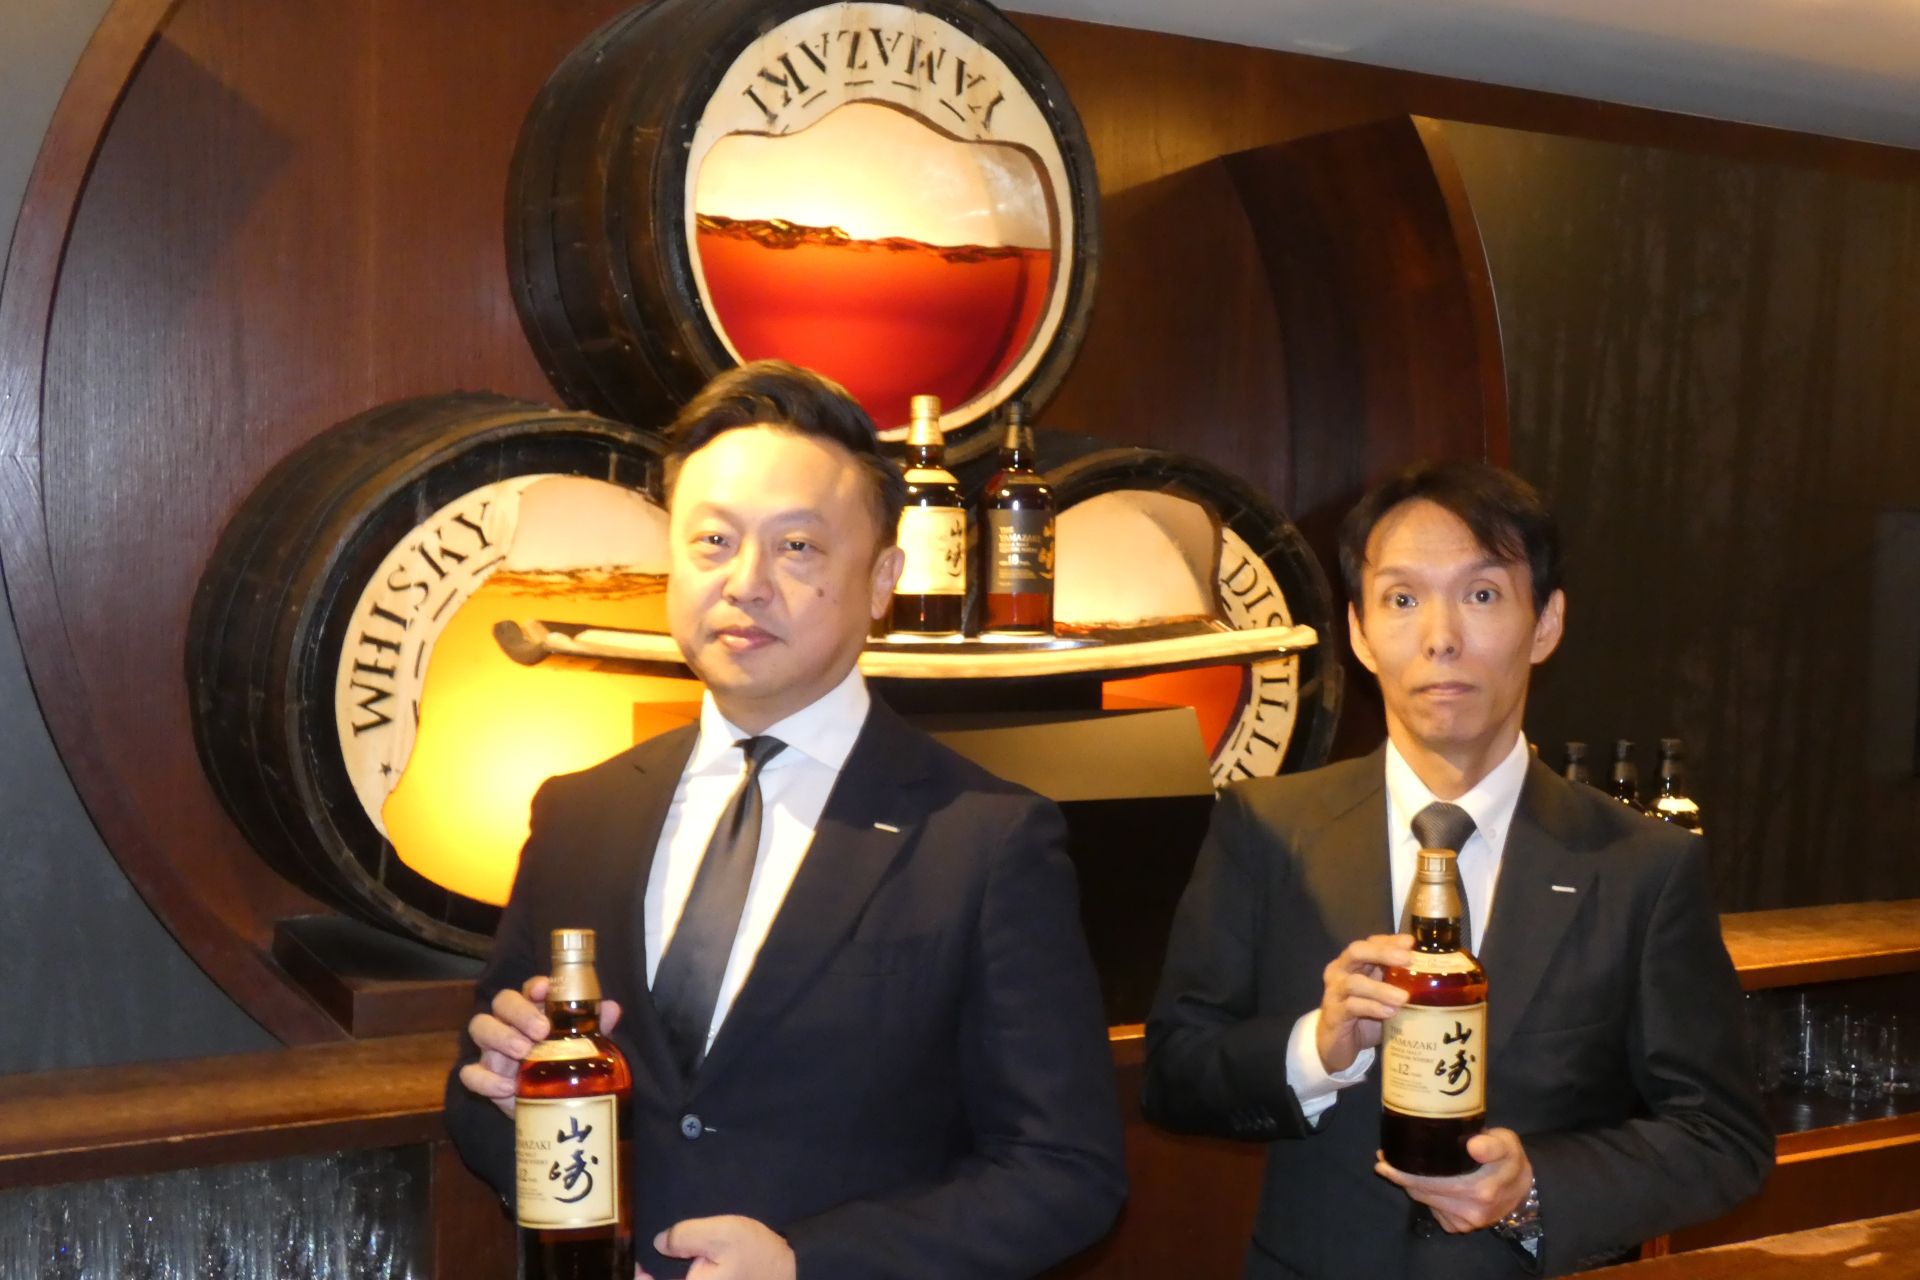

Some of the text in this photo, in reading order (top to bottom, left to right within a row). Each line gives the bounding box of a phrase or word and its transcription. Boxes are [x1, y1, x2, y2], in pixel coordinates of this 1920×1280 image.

[742, 27, 1005, 131] YAMAZAKI
[351, 501, 492, 737] WHISKY
[1390, 1035, 1437, 1050] YAMAZAKI
[1398, 1063, 1409, 1076] 12
[1435, 1021, 1476, 1096] 山崎
[549, 1116, 598, 1203] 山崎
